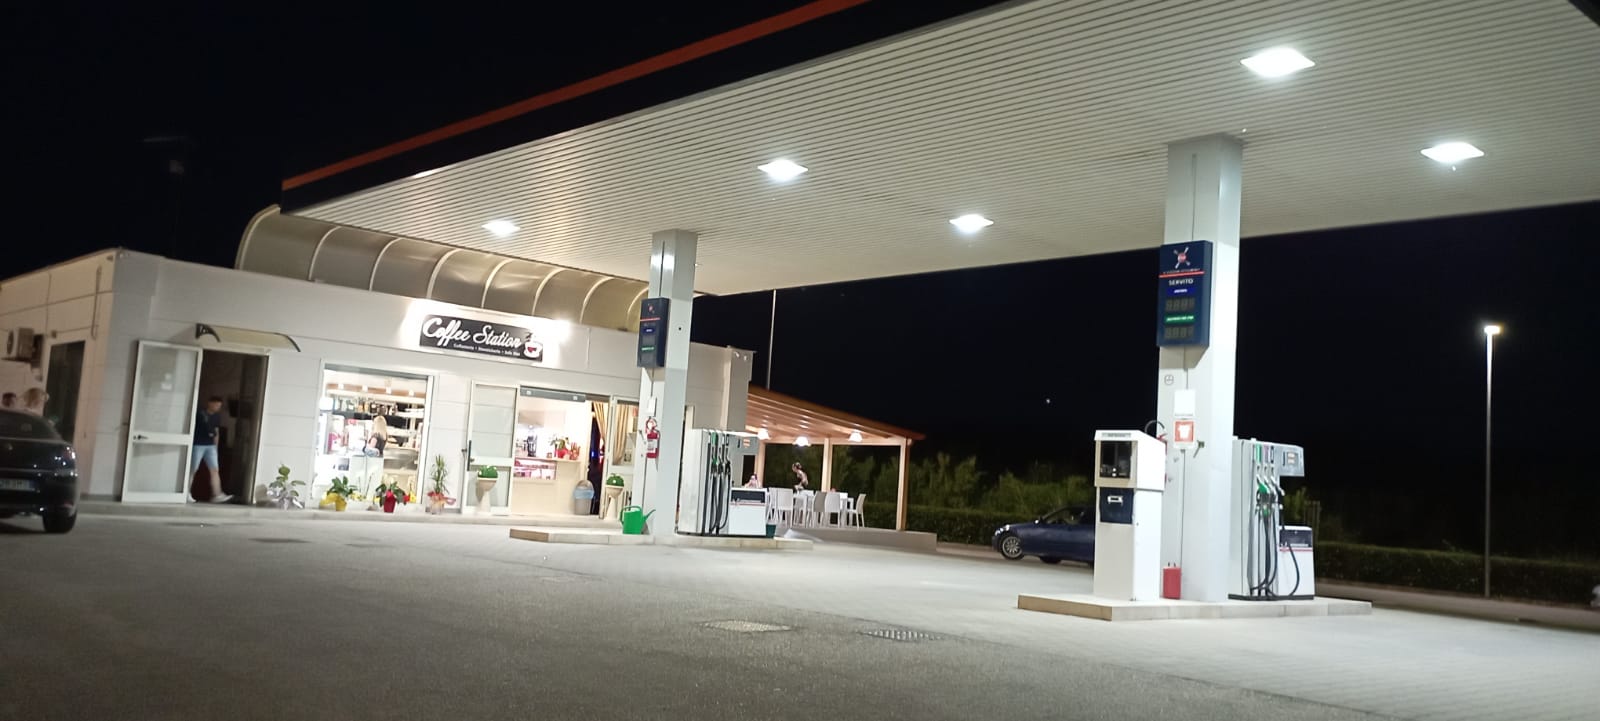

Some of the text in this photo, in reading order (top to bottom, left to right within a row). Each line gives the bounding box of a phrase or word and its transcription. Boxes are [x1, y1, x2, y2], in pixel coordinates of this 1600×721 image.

[1168, 278, 1194, 286] SERVITO
[422, 317, 472, 347] Coffee
[472, 324, 522, 349] Station
